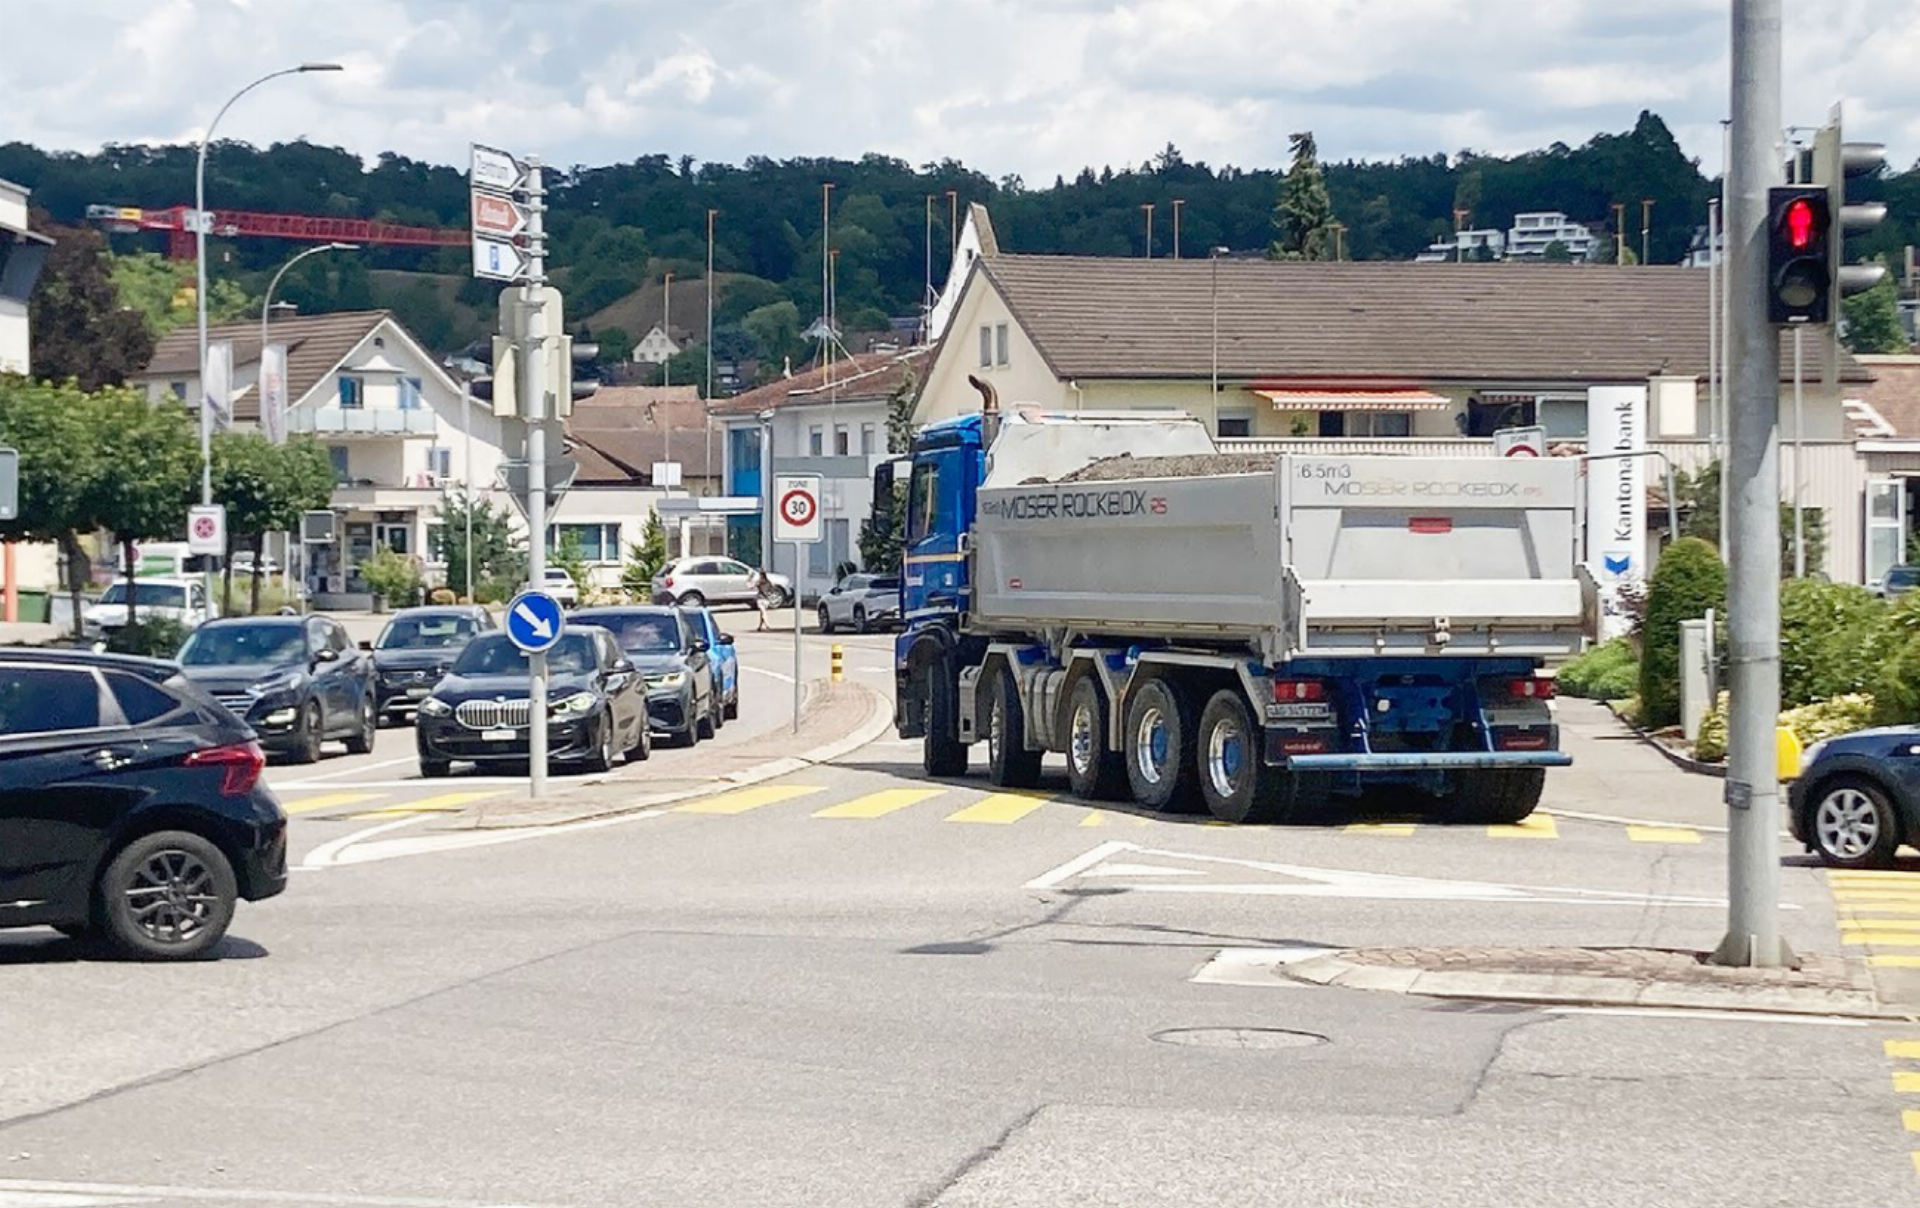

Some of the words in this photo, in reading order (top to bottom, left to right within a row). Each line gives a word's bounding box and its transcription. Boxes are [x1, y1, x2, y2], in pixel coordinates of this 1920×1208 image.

[1614, 401, 1633, 542] Kantonabank
[1324, 480, 1406, 496] MOSER
[1412, 481, 1519, 497] ROCKBOX
[790, 500, 807, 516] 30
[1001, 493, 1058, 520] MOSER
[1062, 490, 1147, 518] ROCKBOX
